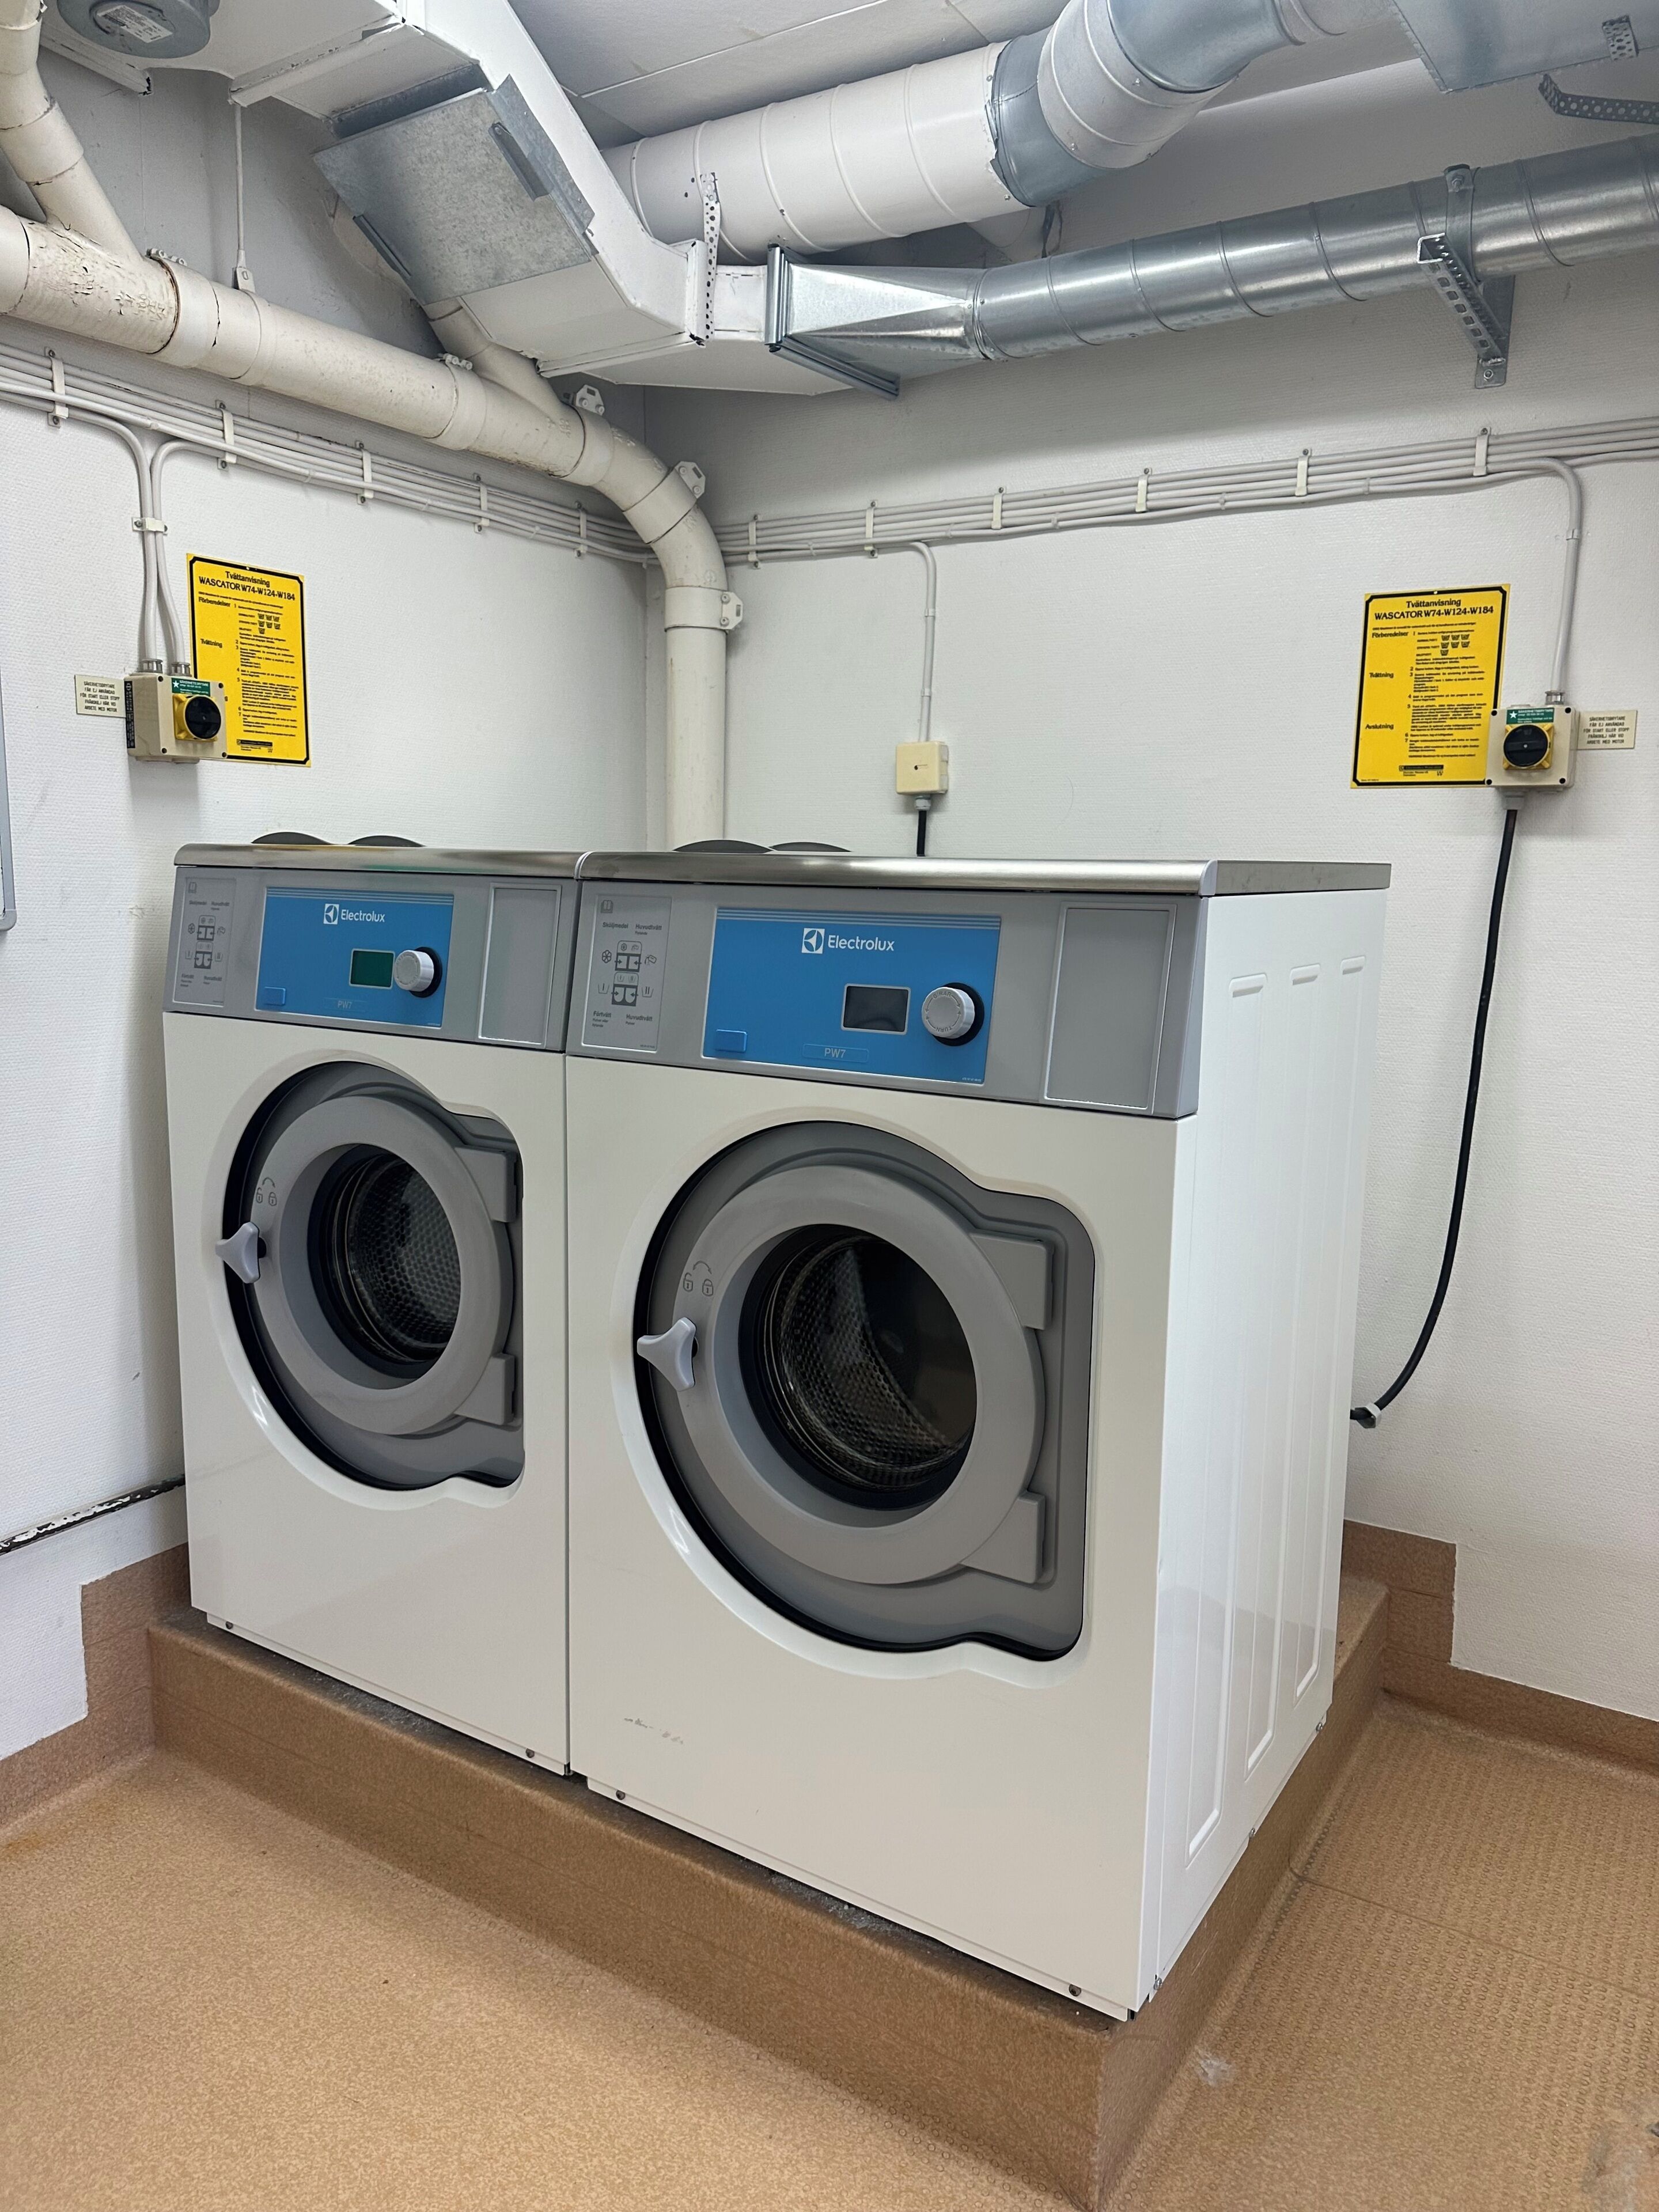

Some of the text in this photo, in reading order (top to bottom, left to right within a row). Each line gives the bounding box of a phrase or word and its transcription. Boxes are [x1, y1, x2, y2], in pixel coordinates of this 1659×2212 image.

[199, 576, 241, 592] WASCATOR
[225, 571, 270, 588] Tvättanvisning
[1406, 599, 1461, 608] Tvättanvisning
[1375, 611, 1422, 620] WASCATOR
[341, 909, 385, 923] Electrolux
[828, 934, 895, 951] Electrolux
[933, 991, 952, 999] GIRAR
[338, 1000, 353, 1009] PW7
[593, 1010, 612, 1018] Förtvätt
[626, 1014, 653, 1022] Huvudtvätt
[824, 1047, 847, 1059] PW7
